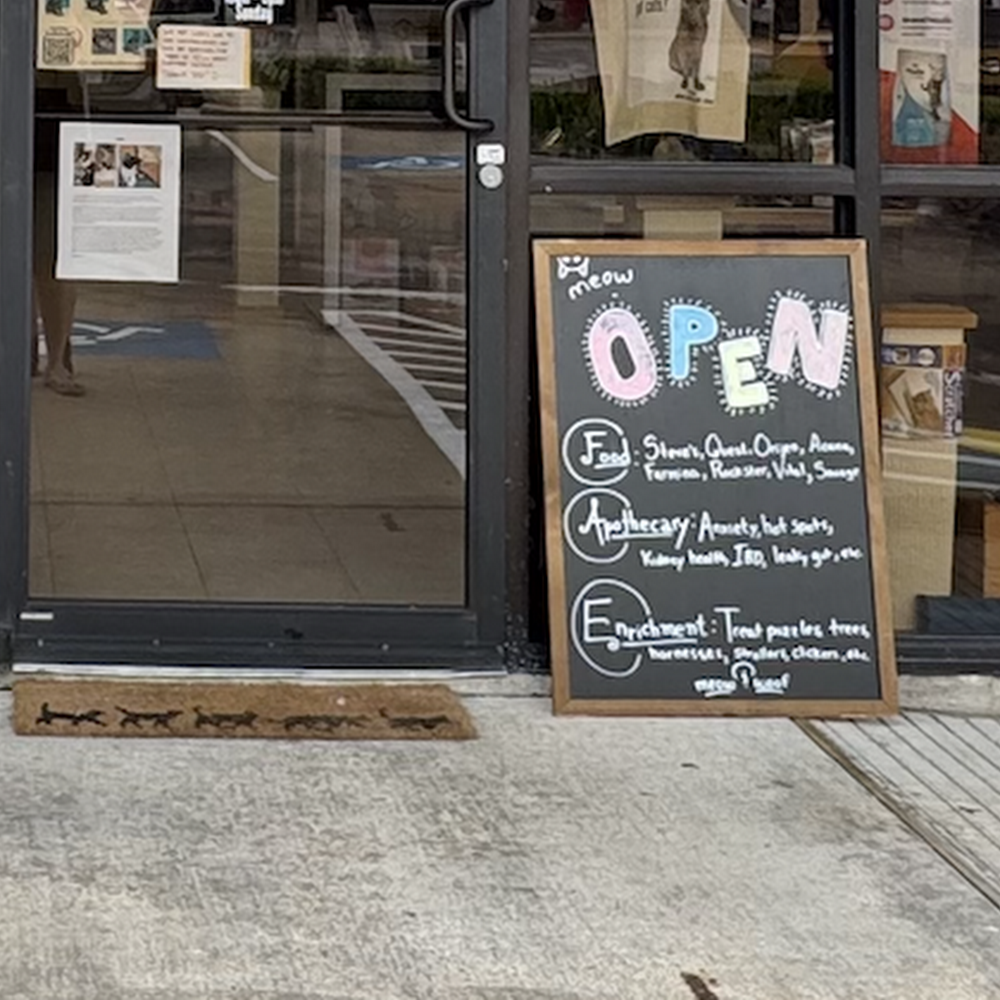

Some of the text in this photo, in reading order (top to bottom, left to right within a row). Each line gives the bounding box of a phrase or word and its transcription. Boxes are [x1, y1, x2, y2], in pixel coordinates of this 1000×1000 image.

[234, 4, 274, 25] Sunday
[568, 268, 635, 300] meow
[587, 296, 849, 409] OPEN
[760, 513, 788, 537] hot
[713, 606, 764, 643] Treat
